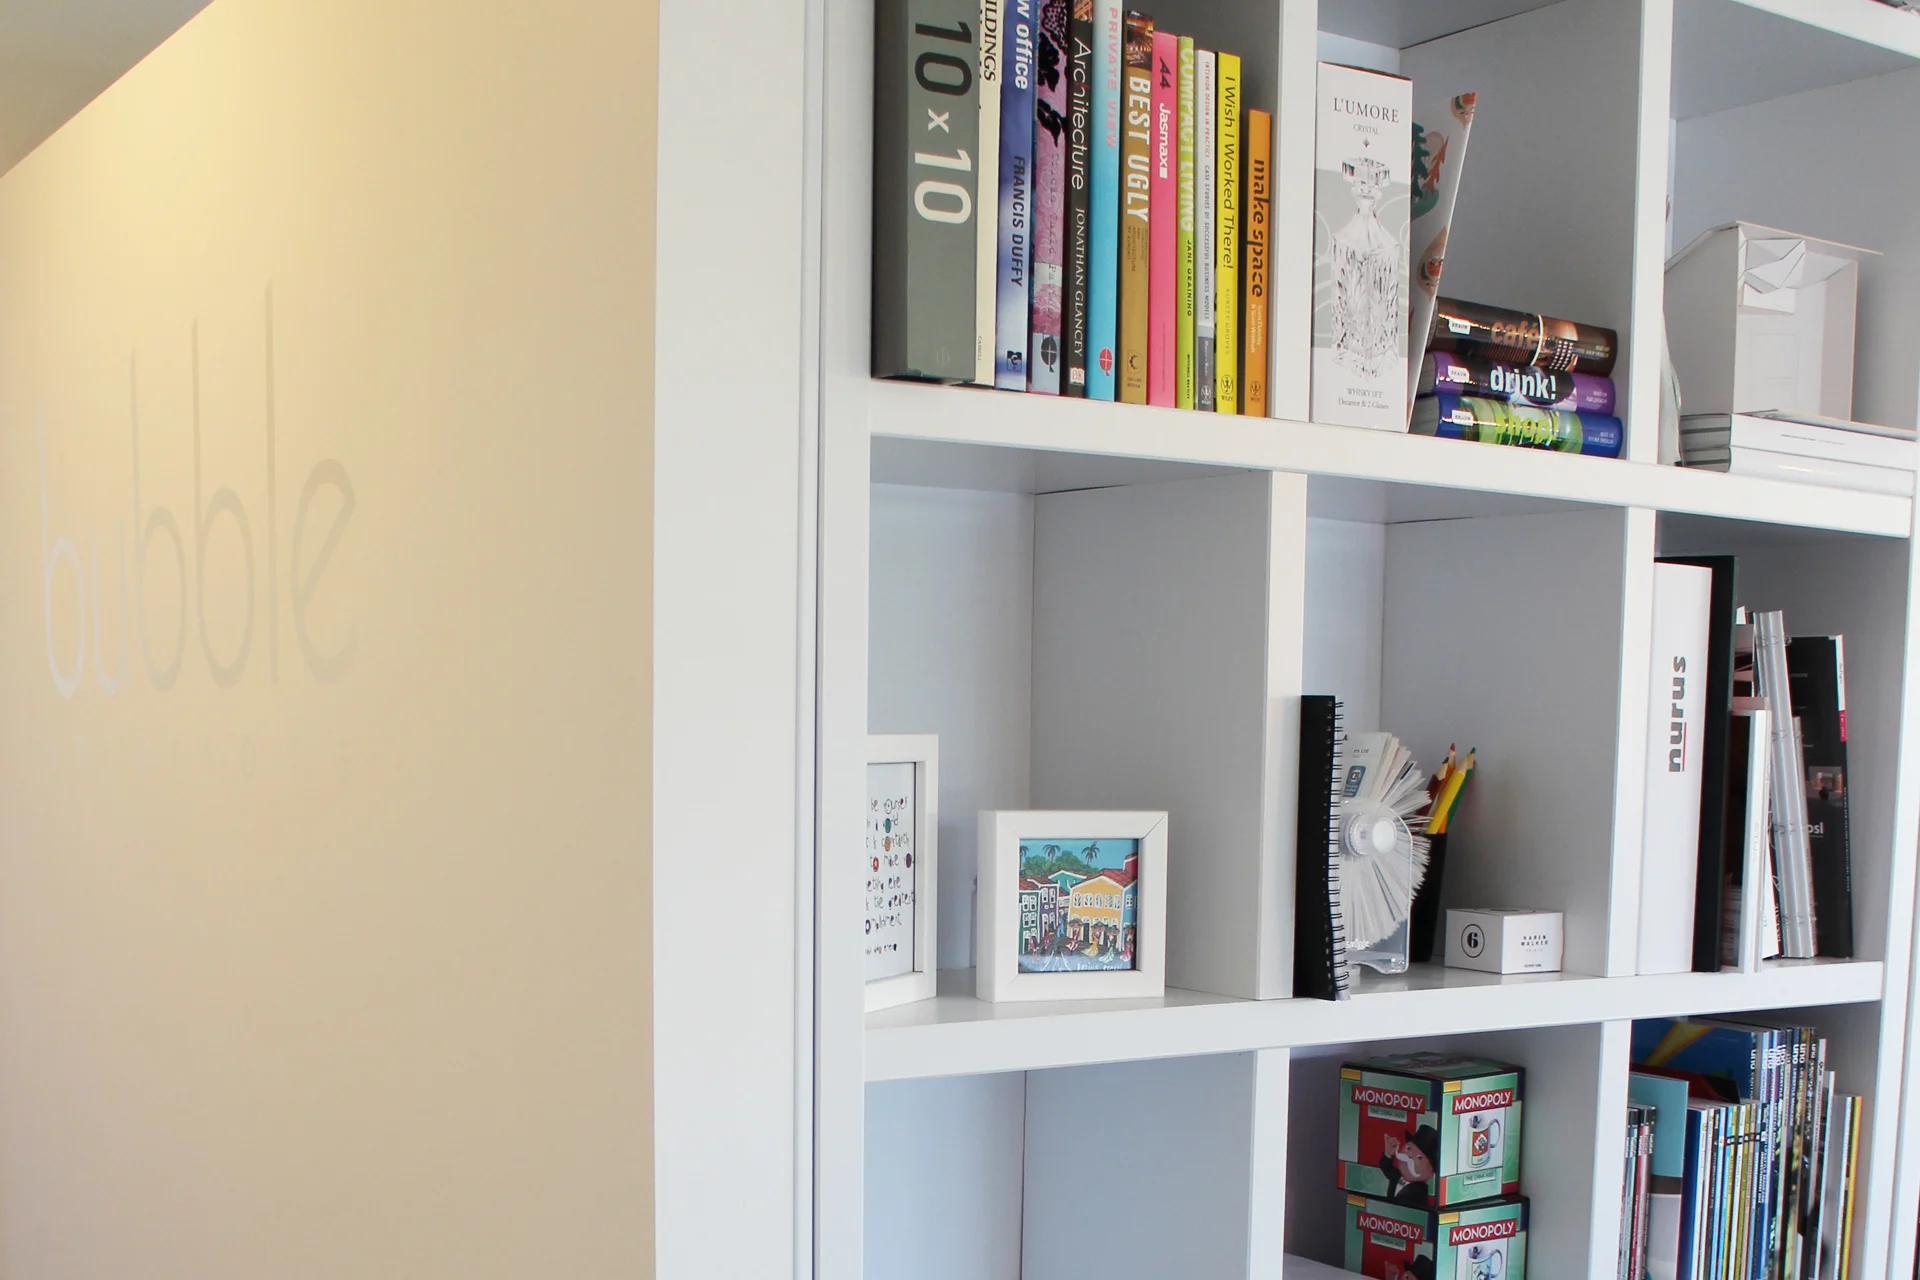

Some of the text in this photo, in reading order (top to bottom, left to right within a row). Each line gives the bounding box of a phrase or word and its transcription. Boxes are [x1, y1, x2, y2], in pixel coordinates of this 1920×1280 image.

[1015, 23, 1032, 90] office
[1106, 7, 1118, 148] PRIVATE VIEW
[914, 20, 972, 225] 10 x 10
[1159, 103, 1171, 167] Jasmax
[1224, 86, 1236, 128] Wish
[1334, 97, 1400, 123] L'UMORE
[1353, 124, 1380, 135] CRYSTAL
[1127, 76, 1151, 222] BEST UGLY
[1180, 48, 1194, 232] COMPACT LIVING
[1070, 36, 1092, 357] Architecture JONATHAN GLANCEY
[1224, 143, 1235, 210] Worked
[1010, 156, 1026, 288] FRANCIS DUFFY
[1223, 215, 1235, 269] There!
[1247, 159, 1270, 298] make space
[1490, 366, 1556, 400] drink!
[37, 278, 358, 699] bubble
[1668, 655, 1686, 772] nurus
[1467, 932, 1479, 948] 6
[1354, 1089, 1424, 1110] MONOPOLY
[1455, 1091, 1512, 1111] MONOPOLY
[1359, 1216, 1421, 1240] MONOPOLY
[1452, 1222, 1514, 1242] MONOPOLY
